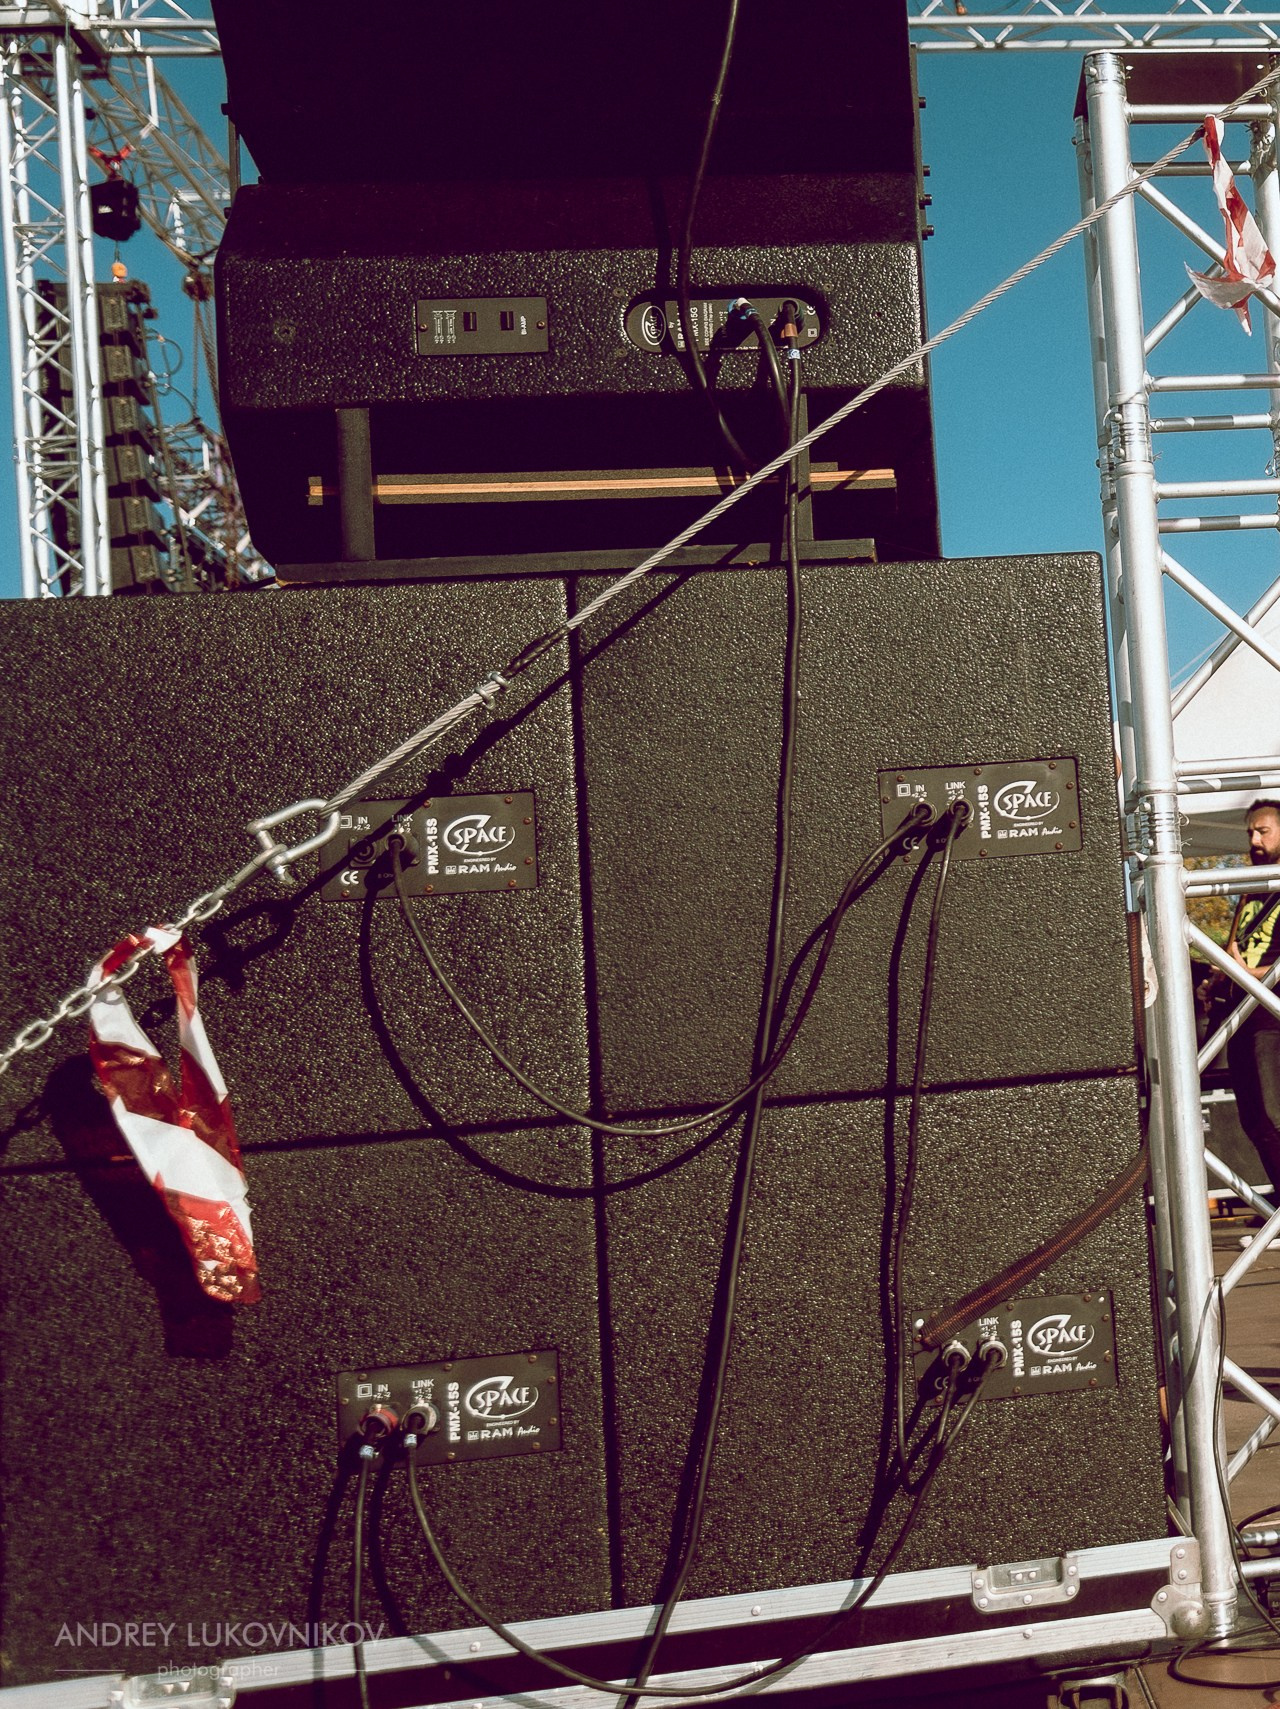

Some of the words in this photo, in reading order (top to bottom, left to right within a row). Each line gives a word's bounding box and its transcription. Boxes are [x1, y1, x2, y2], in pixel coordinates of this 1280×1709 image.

[690, 306, 699, 341] MX-15G
[915, 784, 925, 792] IN
[945, 781, 966, 790] LINK
[977, 784, 992, 839] PMX-15S
[358, 816, 368, 824] IN
[391, 814, 413, 823] LINK
[1009, 827, 1039, 838] RAM
[1041, 826, 1063, 836] Audio
[426, 818, 439, 875] PMX-15S
[458, 863, 490, 874] RAM
[494, 862, 517, 873] Audio
[979, 1316, 999, 1326] LINK
[1010, 1319, 1025, 1377] PMX-15S
[1042, 1363, 1073, 1375] RAM
[1075, 1361, 1097, 1372] Audio
[378, 1383, 389, 1392] IN
[412, 1379, 434, 1389] LINK
[448, 1381, 461, 1440] PMX-15S
[481, 1427, 513, 1439] RAM
[517, 1424, 540, 1436] Audio
